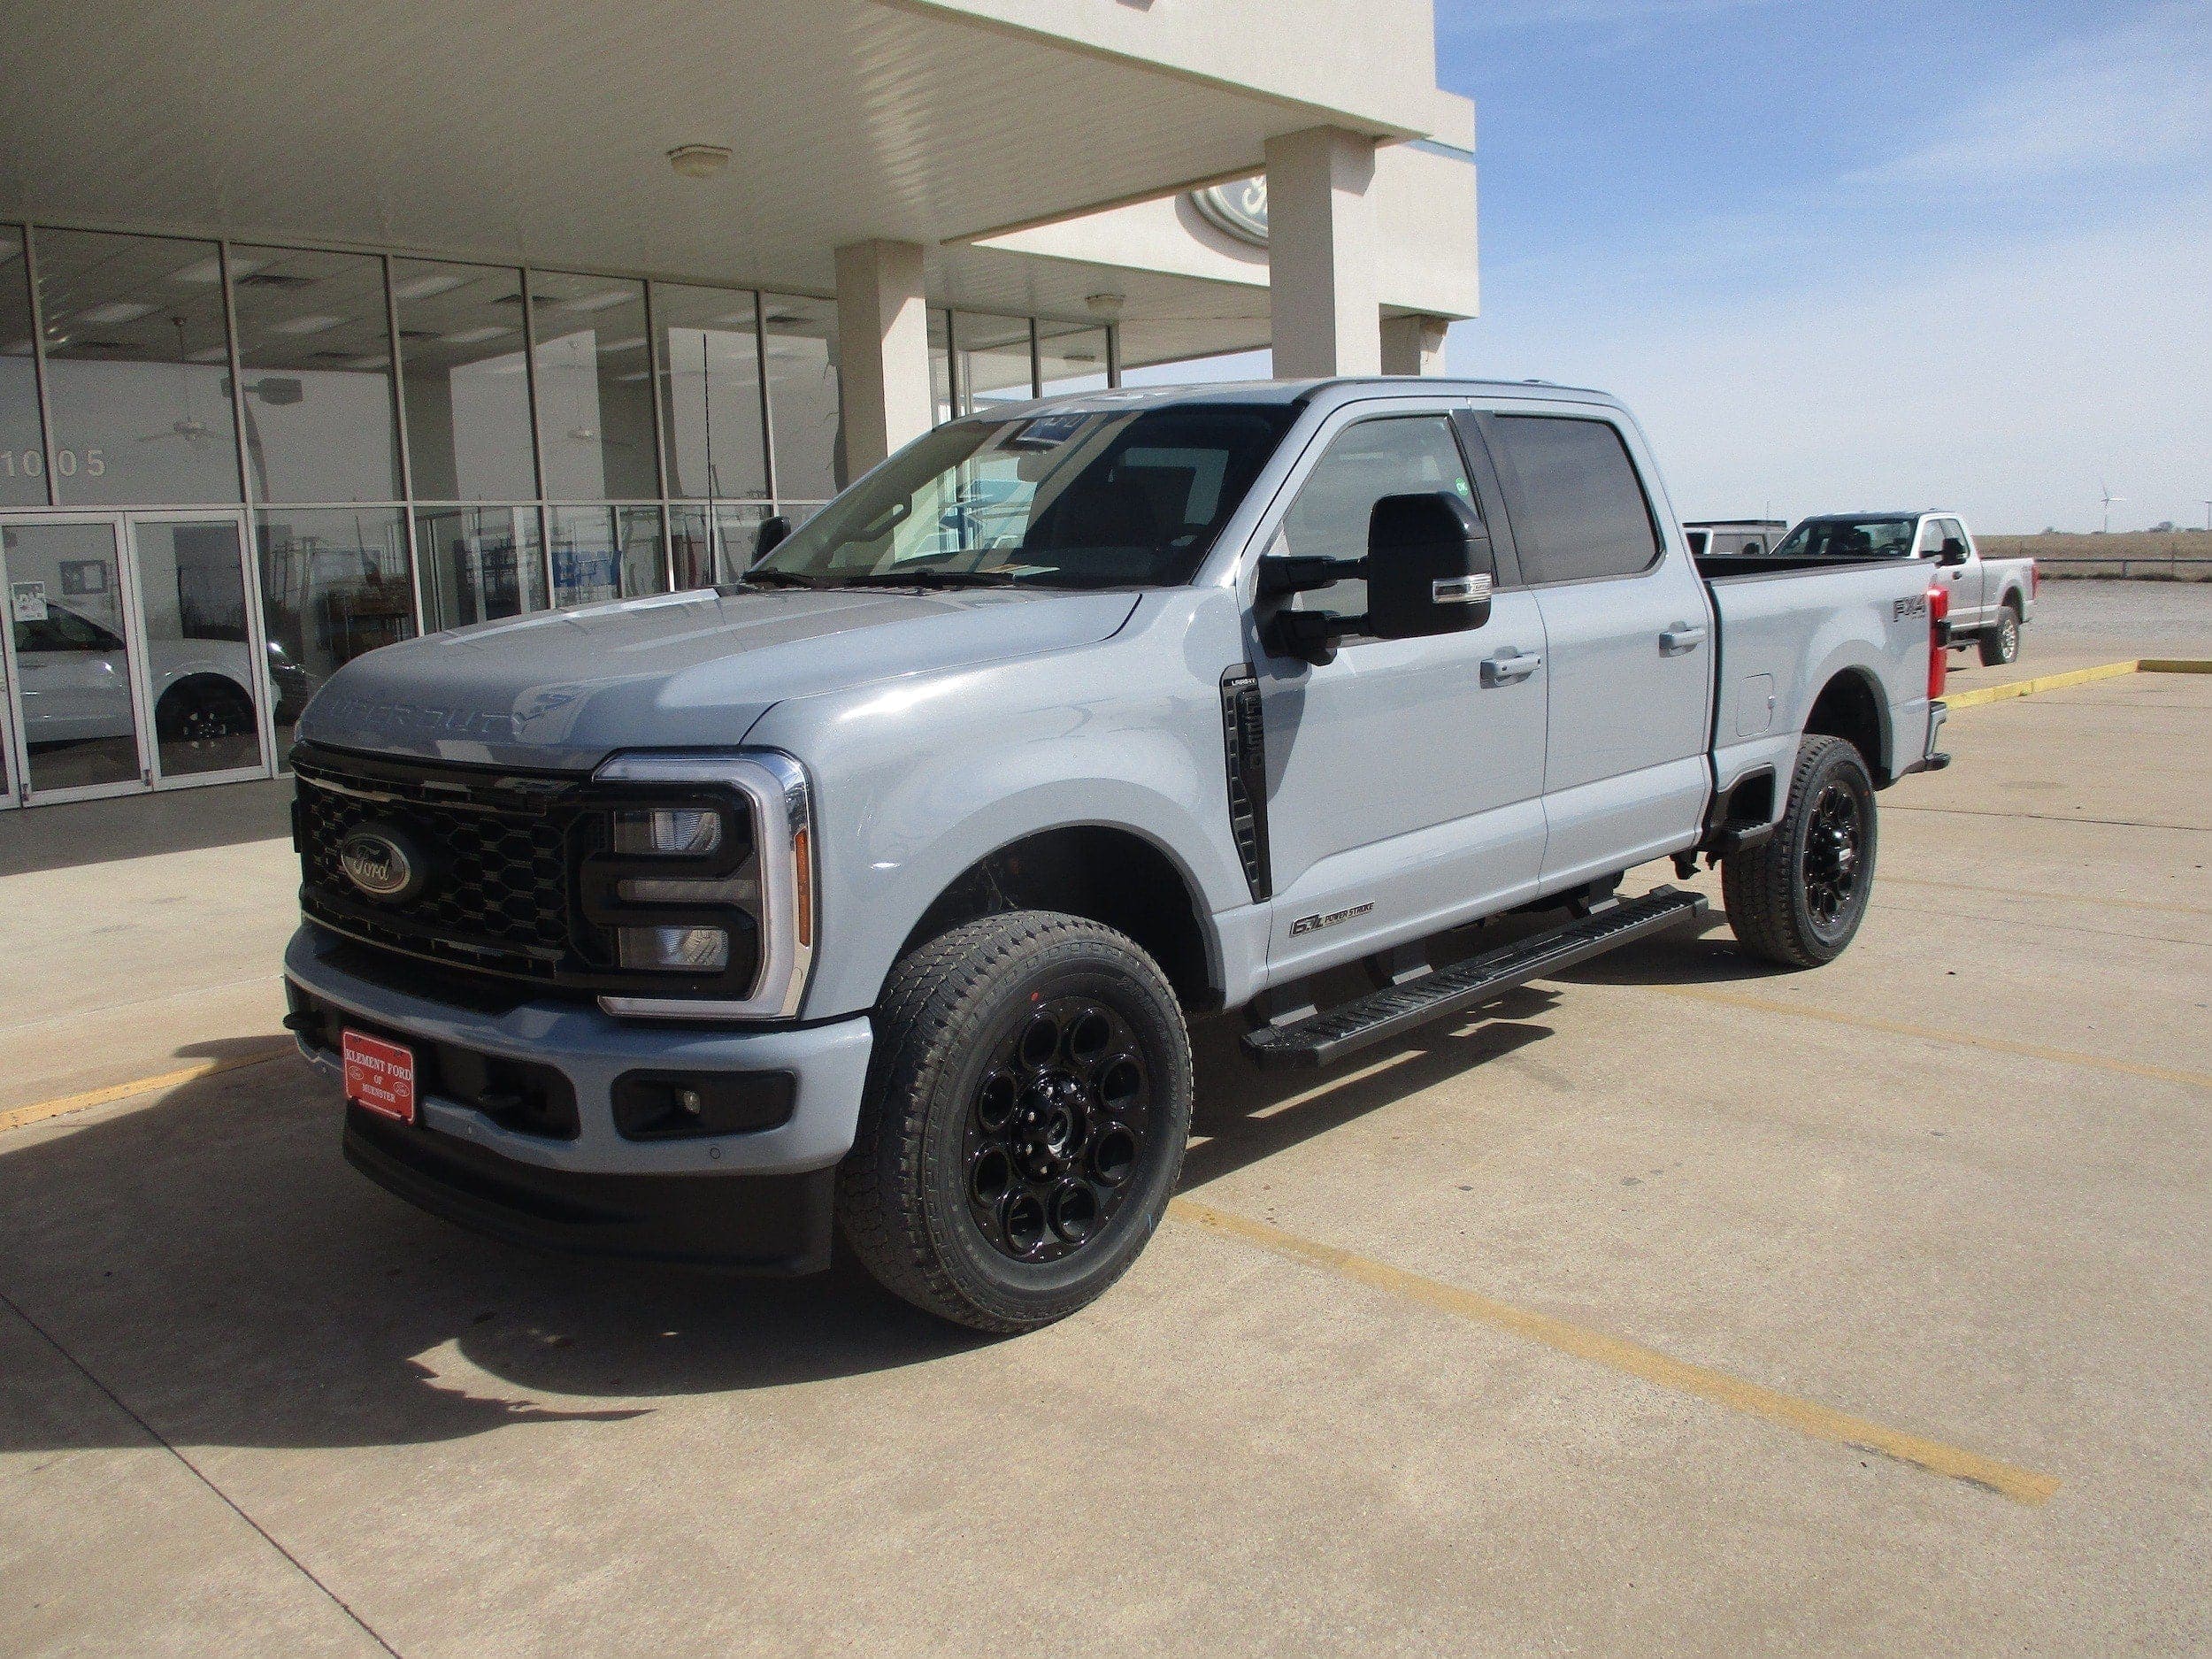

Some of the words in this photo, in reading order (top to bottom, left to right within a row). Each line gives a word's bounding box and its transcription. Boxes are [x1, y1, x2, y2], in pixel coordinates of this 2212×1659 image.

[0, 449, 105, 477] 1005
[1893, 595, 1926, 623] FX4
[353, 845, 390, 881] Ford
[1292, 913, 1324, 935] 6.7L
[1325, 910, 1348, 923] POWER
[1348, 902, 1374, 917] STROKE
[345, 1048, 385, 1072] KLEMENT
[387, 1063, 411, 1080] FORD
[373, 1074, 383, 1085] OF
